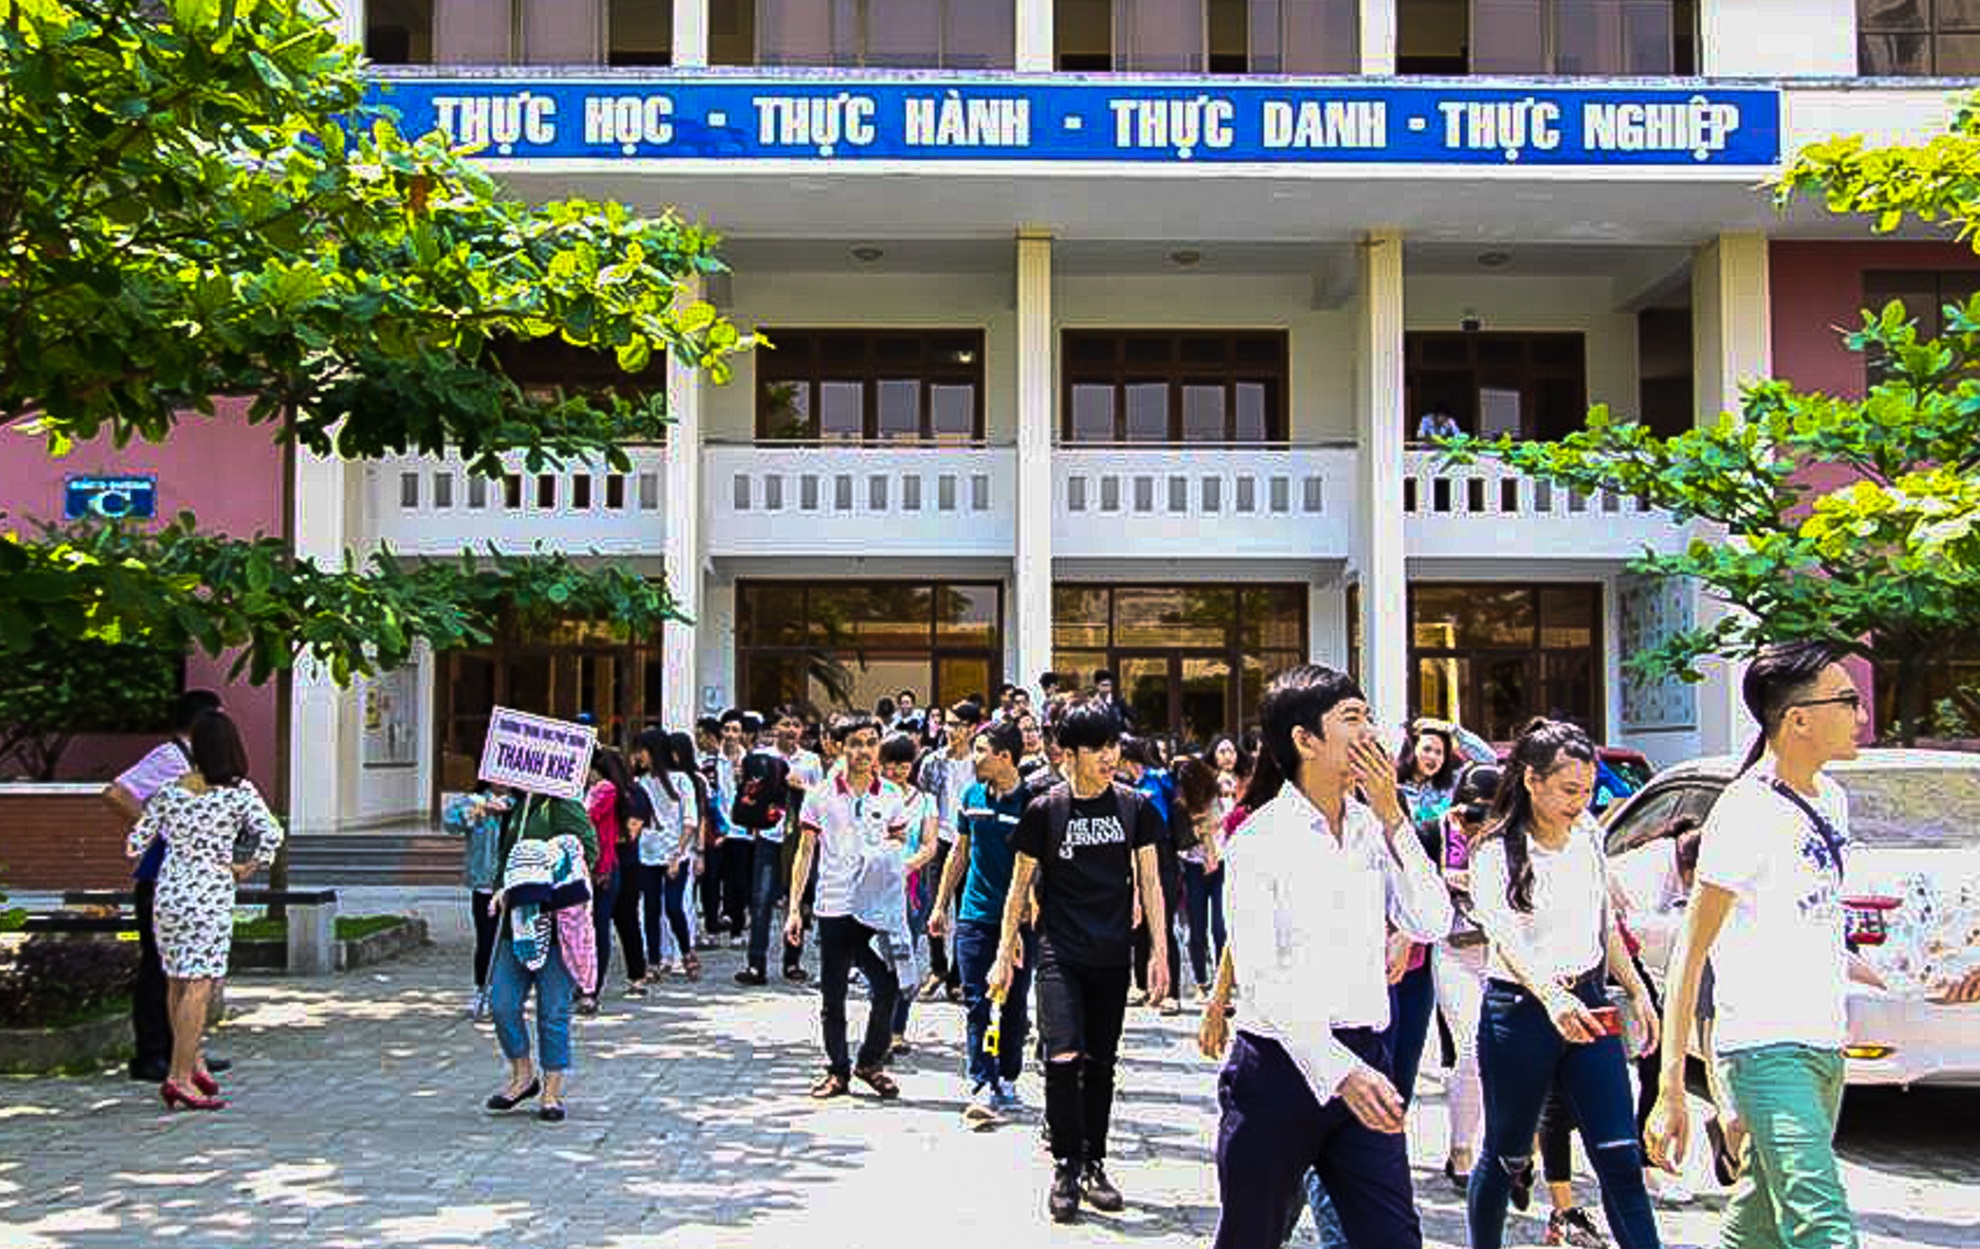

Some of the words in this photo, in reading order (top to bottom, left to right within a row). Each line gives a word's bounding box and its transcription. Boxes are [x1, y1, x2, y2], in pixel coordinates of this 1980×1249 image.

[432, 91, 556, 155] THỰC
[584, 96, 674, 155] HỌC
[752, 92, 876, 156] THỰC
[904, 88, 1031, 147] HÀNH
[1110, 95, 1235, 159] THỰC
[1262, 101, 1387, 149] DANH
[1438, 97, 1560, 161] THỰC
[1584, 95, 1739, 161] NGHIỆP
[496, 742, 546, 775] THANH
